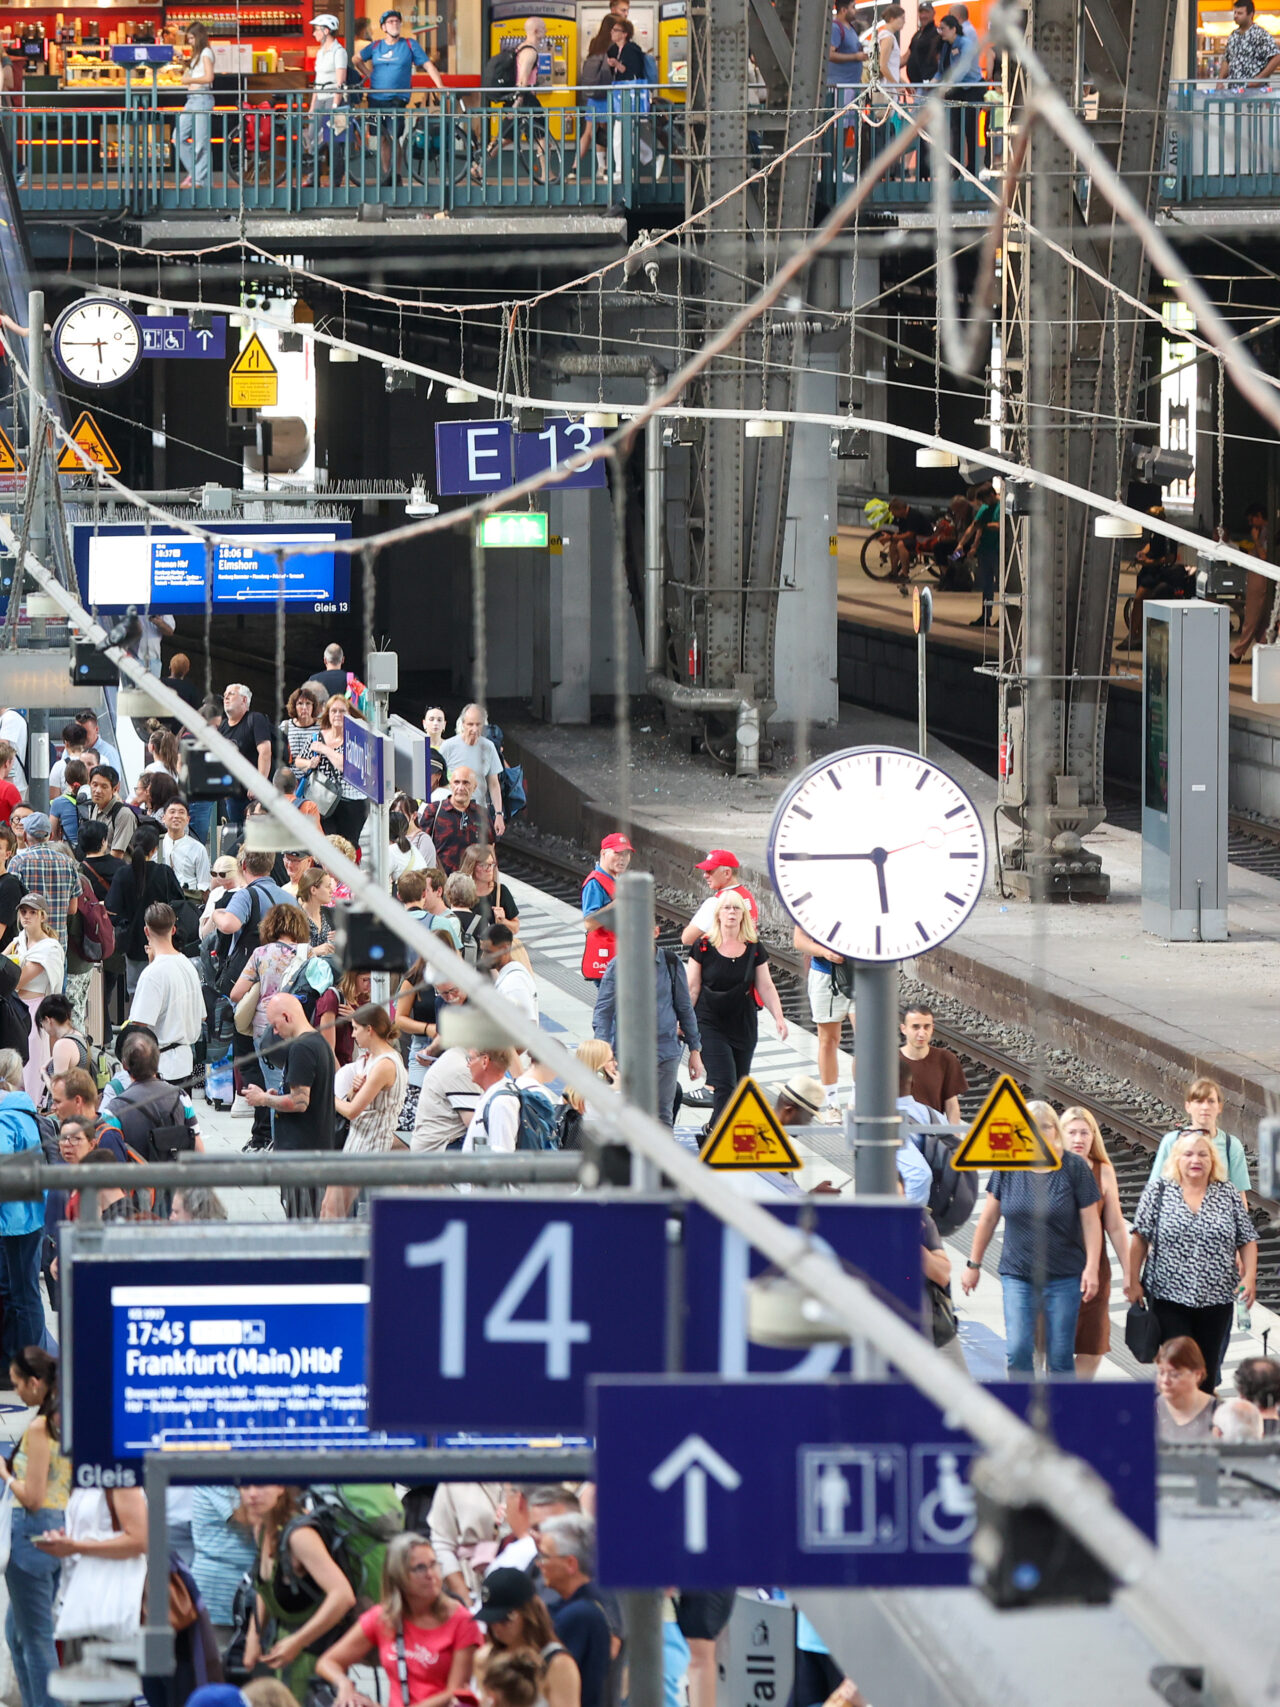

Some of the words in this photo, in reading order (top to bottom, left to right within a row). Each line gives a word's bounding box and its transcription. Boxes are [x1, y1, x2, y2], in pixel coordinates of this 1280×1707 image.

[467, 427, 501, 481] E
[539, 423, 593, 473] 13
[218, 560, 259, 570] Elmshorn
[219, 549, 242, 558] 18:06
[314, 603, 337, 612] Gleis
[339, 602, 348, 612] 13
[404, 1219, 591, 1381] 14
[126, 1321, 185, 1346] 17:45
[126, 1347, 343, 1380] Frankfurt(Main)Hbf
[76, 1463, 136, 1488] Gleis
